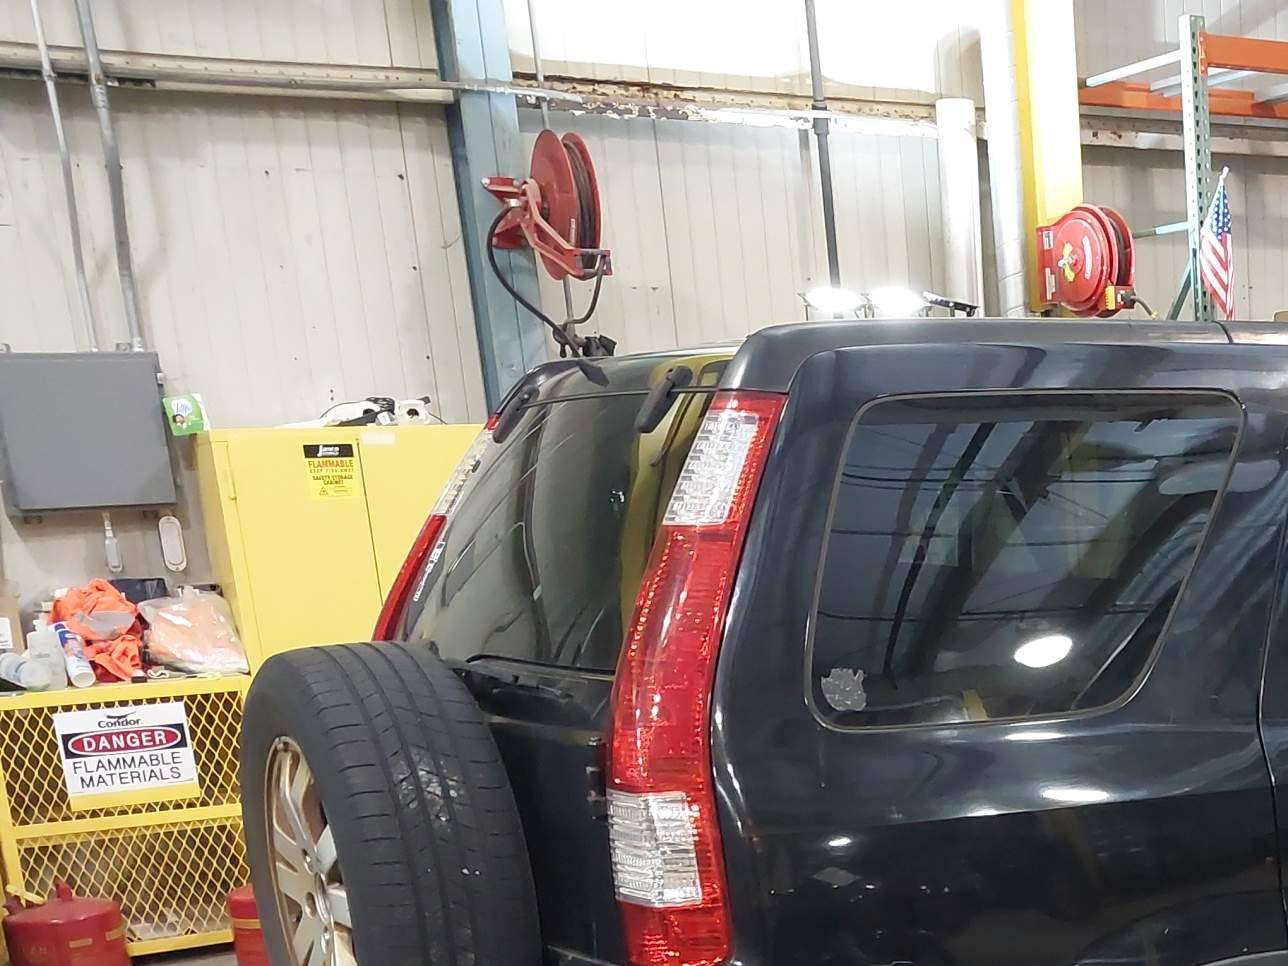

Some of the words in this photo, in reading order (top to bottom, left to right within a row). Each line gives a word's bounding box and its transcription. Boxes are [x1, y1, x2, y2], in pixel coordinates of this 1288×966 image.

[308, 460, 354, 468] FLAMMABLE
[98, 718, 141, 729] Condor
[82, 730, 167, 752] DANGER
[73, 752, 183, 774] FLAMMABLE
[80, 766, 181, 789] MATERIALS
